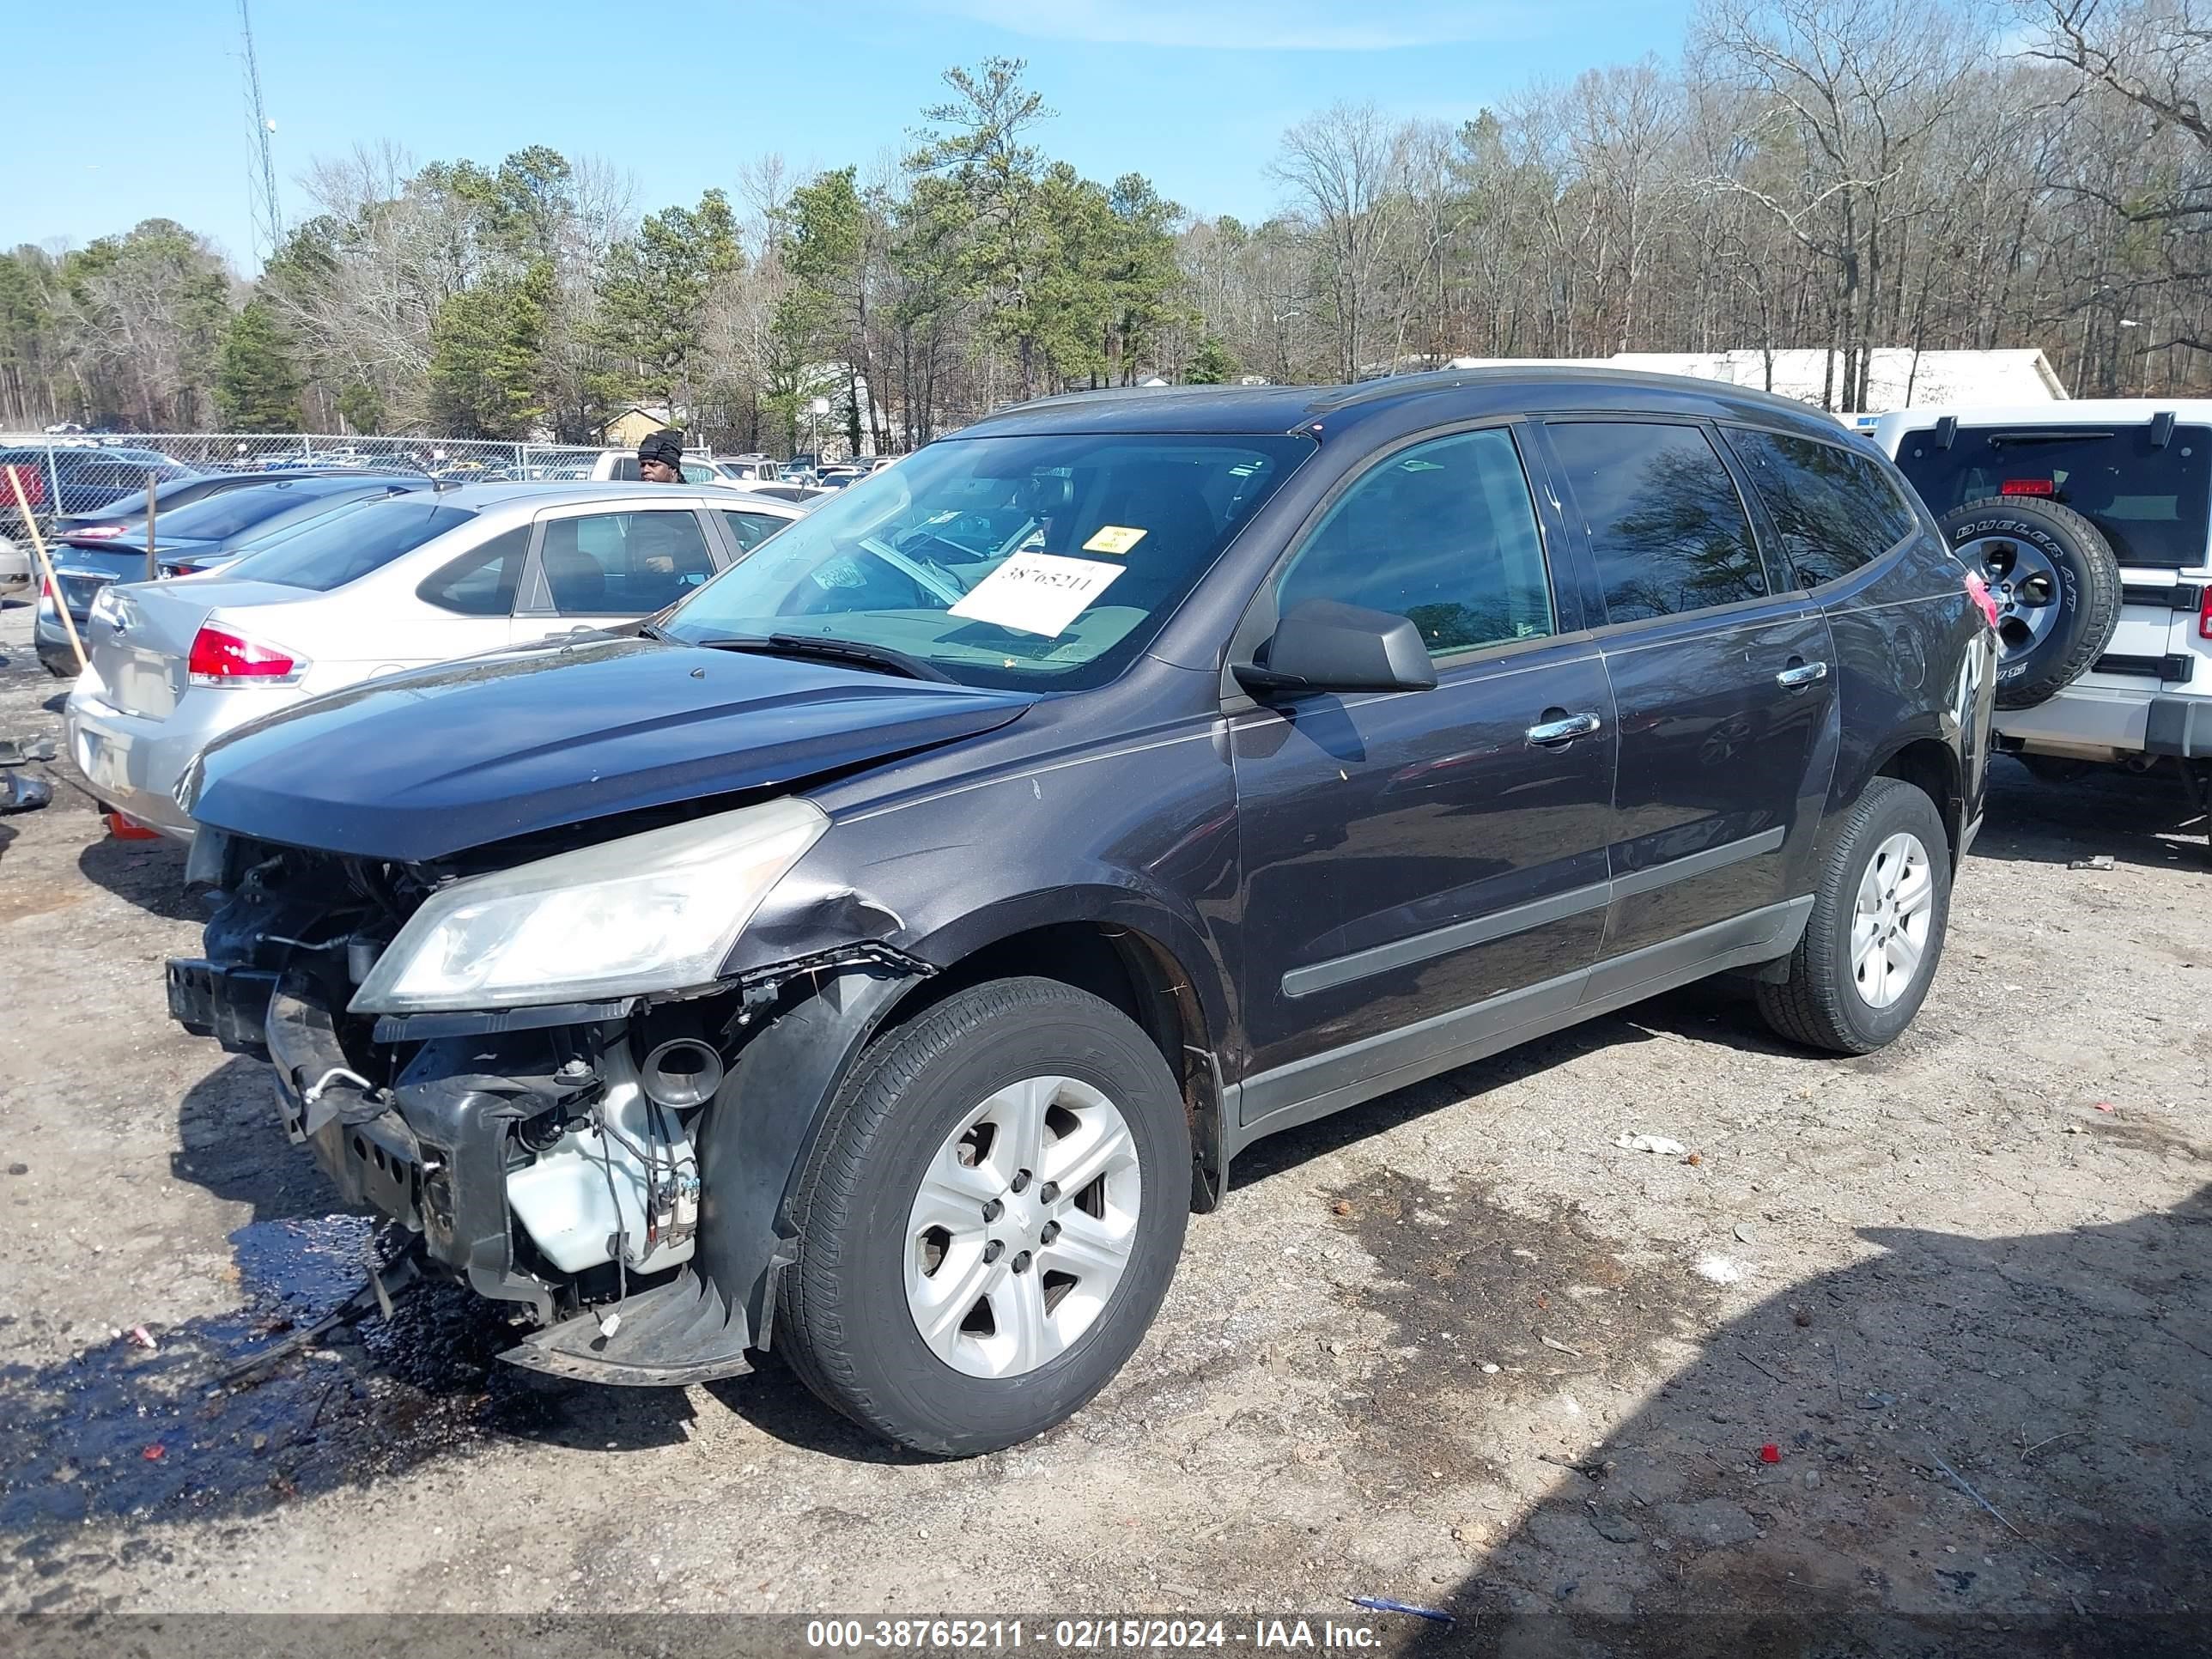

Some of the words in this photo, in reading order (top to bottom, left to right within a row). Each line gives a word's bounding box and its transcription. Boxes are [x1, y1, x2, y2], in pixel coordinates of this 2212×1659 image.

[1001, 567, 1092, 591] 38765211
[1955, 520, 2064, 559] DUELER
[2061, 565, 2077, 613] A/T
